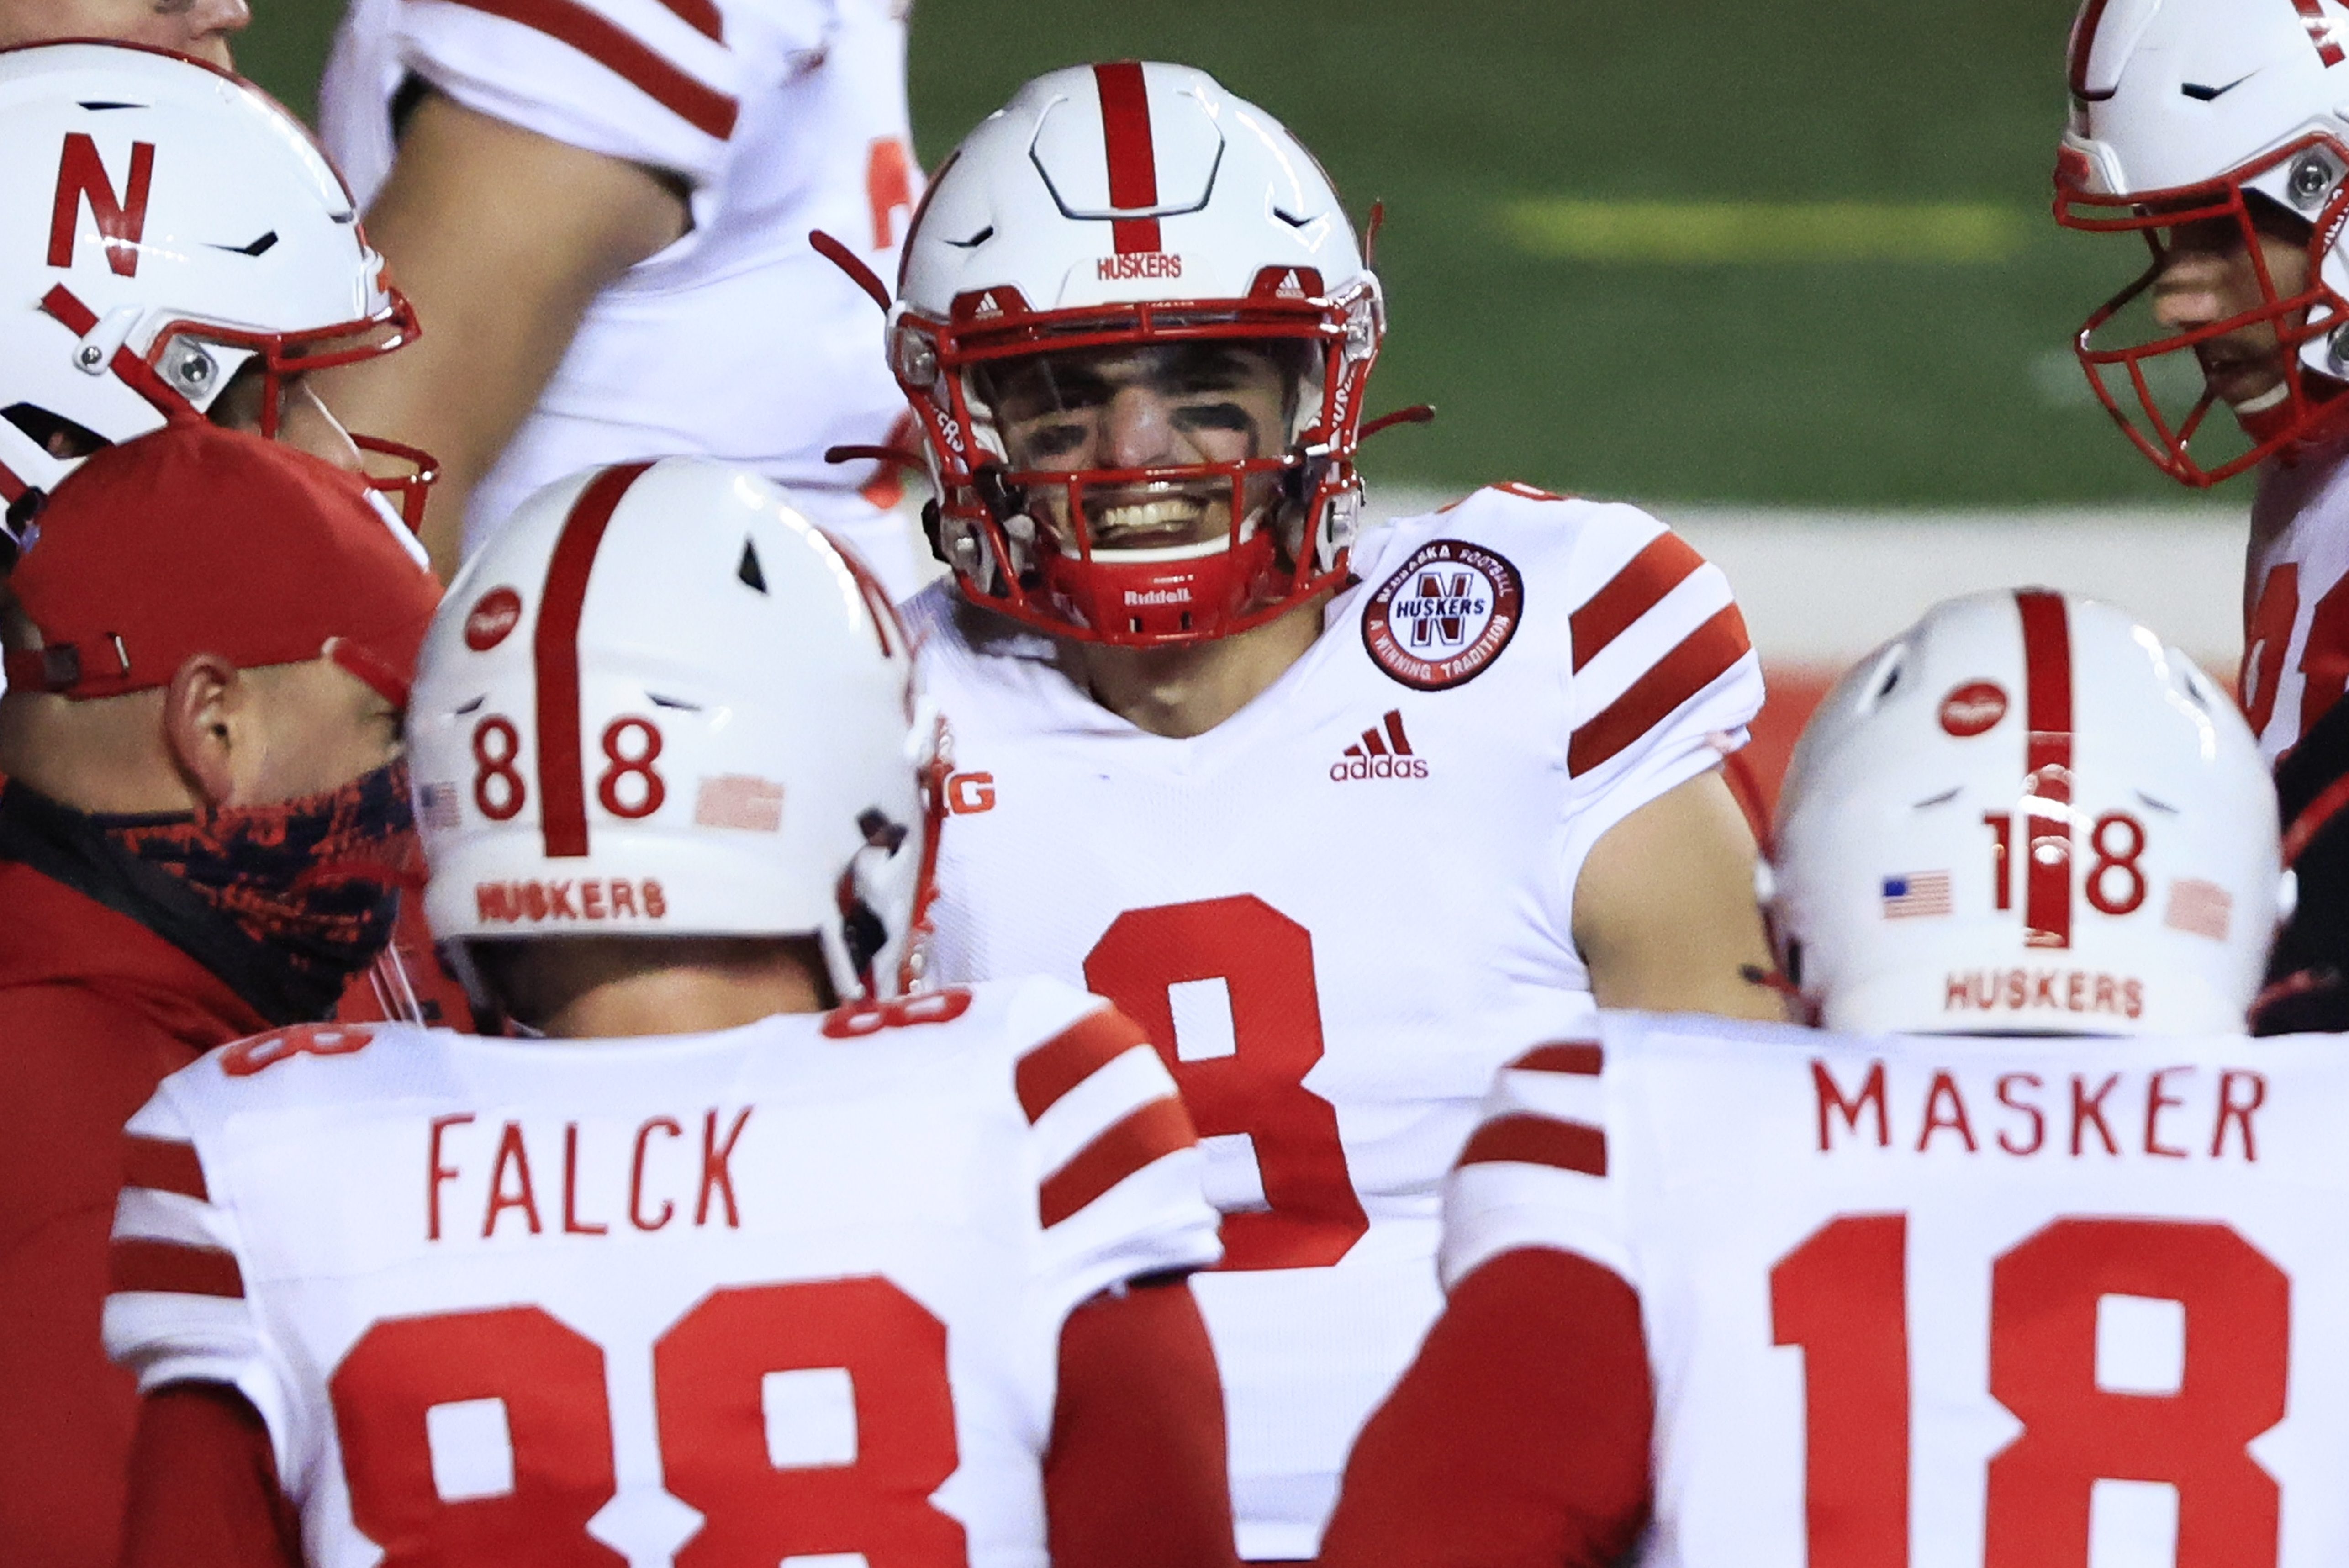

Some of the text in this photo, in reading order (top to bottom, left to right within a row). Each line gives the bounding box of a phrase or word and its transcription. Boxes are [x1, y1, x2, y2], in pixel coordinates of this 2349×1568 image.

[47, 132, 155, 278] N
[1097, 254, 1181, 281] HUSKERS
[1459, 549, 1514, 597] FOOTBALL
[1396, 598, 1485, 618] HUSKERS
[1370, 614, 1510, 680] A WINNING TRADITION
[1330, 754, 1429, 781] adidas
[475, 878, 667, 923] HUSKERS
[1944, 968, 2144, 1019] HUSKERS
[1082, 892, 1369, 1271] 8
[1809, 1057, 2270, 1163] MASKER
[426, 1104, 755, 1241] FALCK
[328, 1272, 969, 1568] 88
[1768, 1209, 2291, 1568] 18
